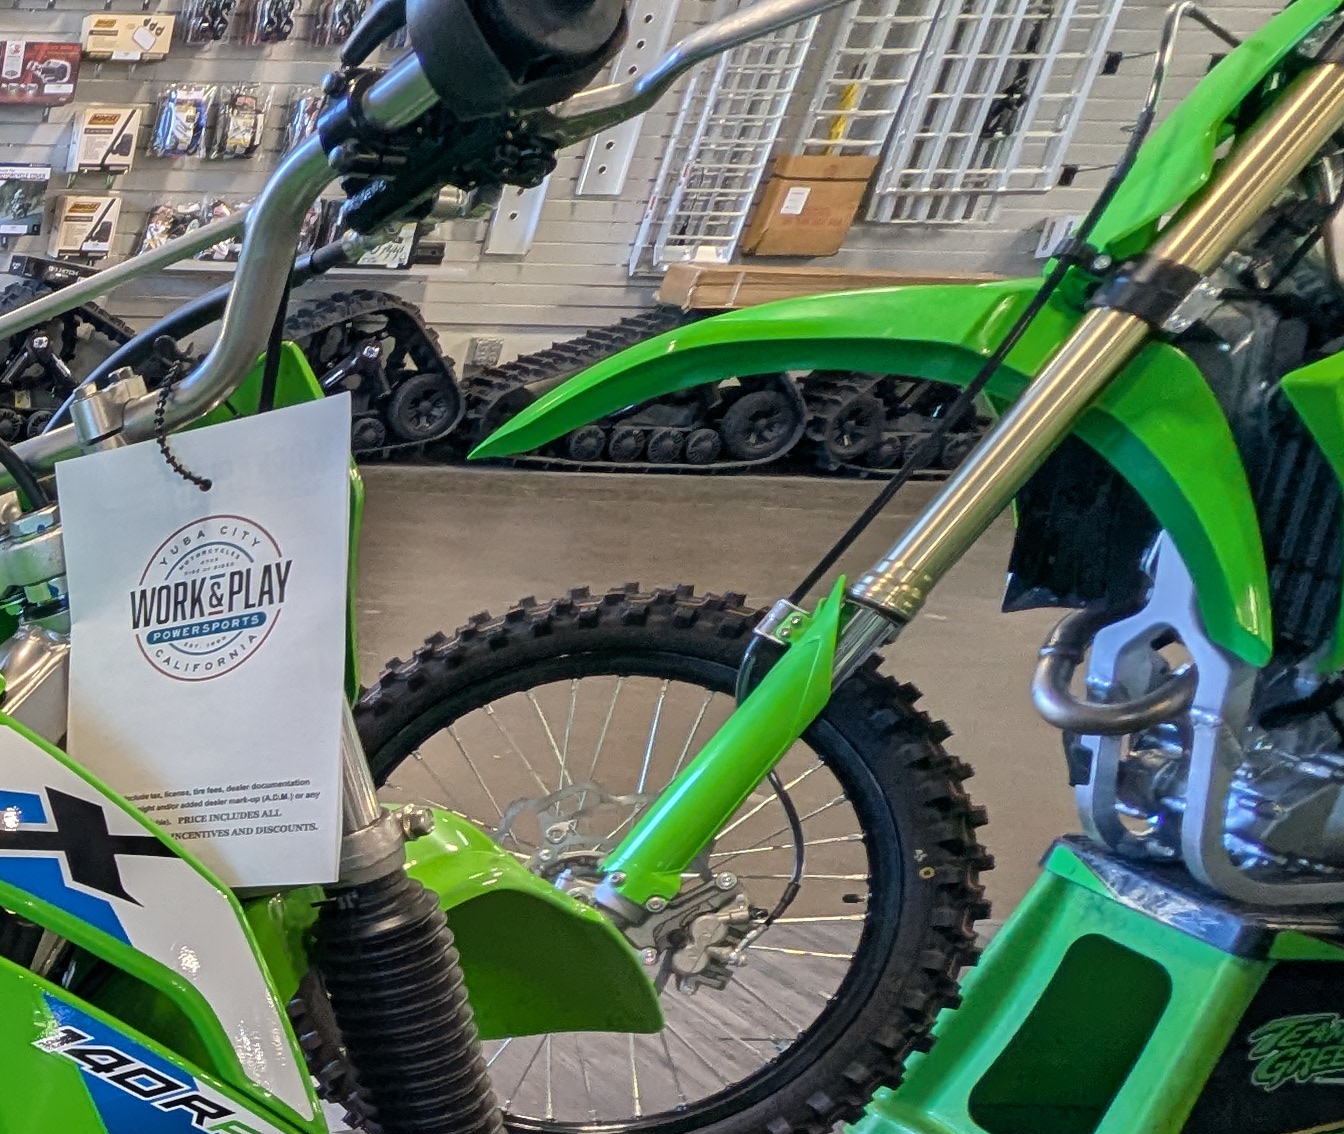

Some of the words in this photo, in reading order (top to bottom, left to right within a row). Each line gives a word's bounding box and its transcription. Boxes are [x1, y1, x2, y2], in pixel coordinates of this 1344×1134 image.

[159, 529, 206, 567] YUBA
[220, 525, 260, 548] CITY
[130, 559, 293, 630] WORK&PLAY
[152, 614, 260, 642] POWERSPORTS
[155, 633, 258, 673] CALIFORNIA
[226, 784, 251, 793] dealer
[252, 779, 310, 791] documentation
[180, 800, 203, 809] added
[204, 798, 228, 808] dealer
[306, 791, 321, 800] any
[178, 815, 207, 825] PRICE
[209, 810, 260, 822] INCLUDES
[261, 809, 283, 818] ALL
[231, 826, 253, 836] AND
[256, 823, 318, 835] DISCOUNTS.
